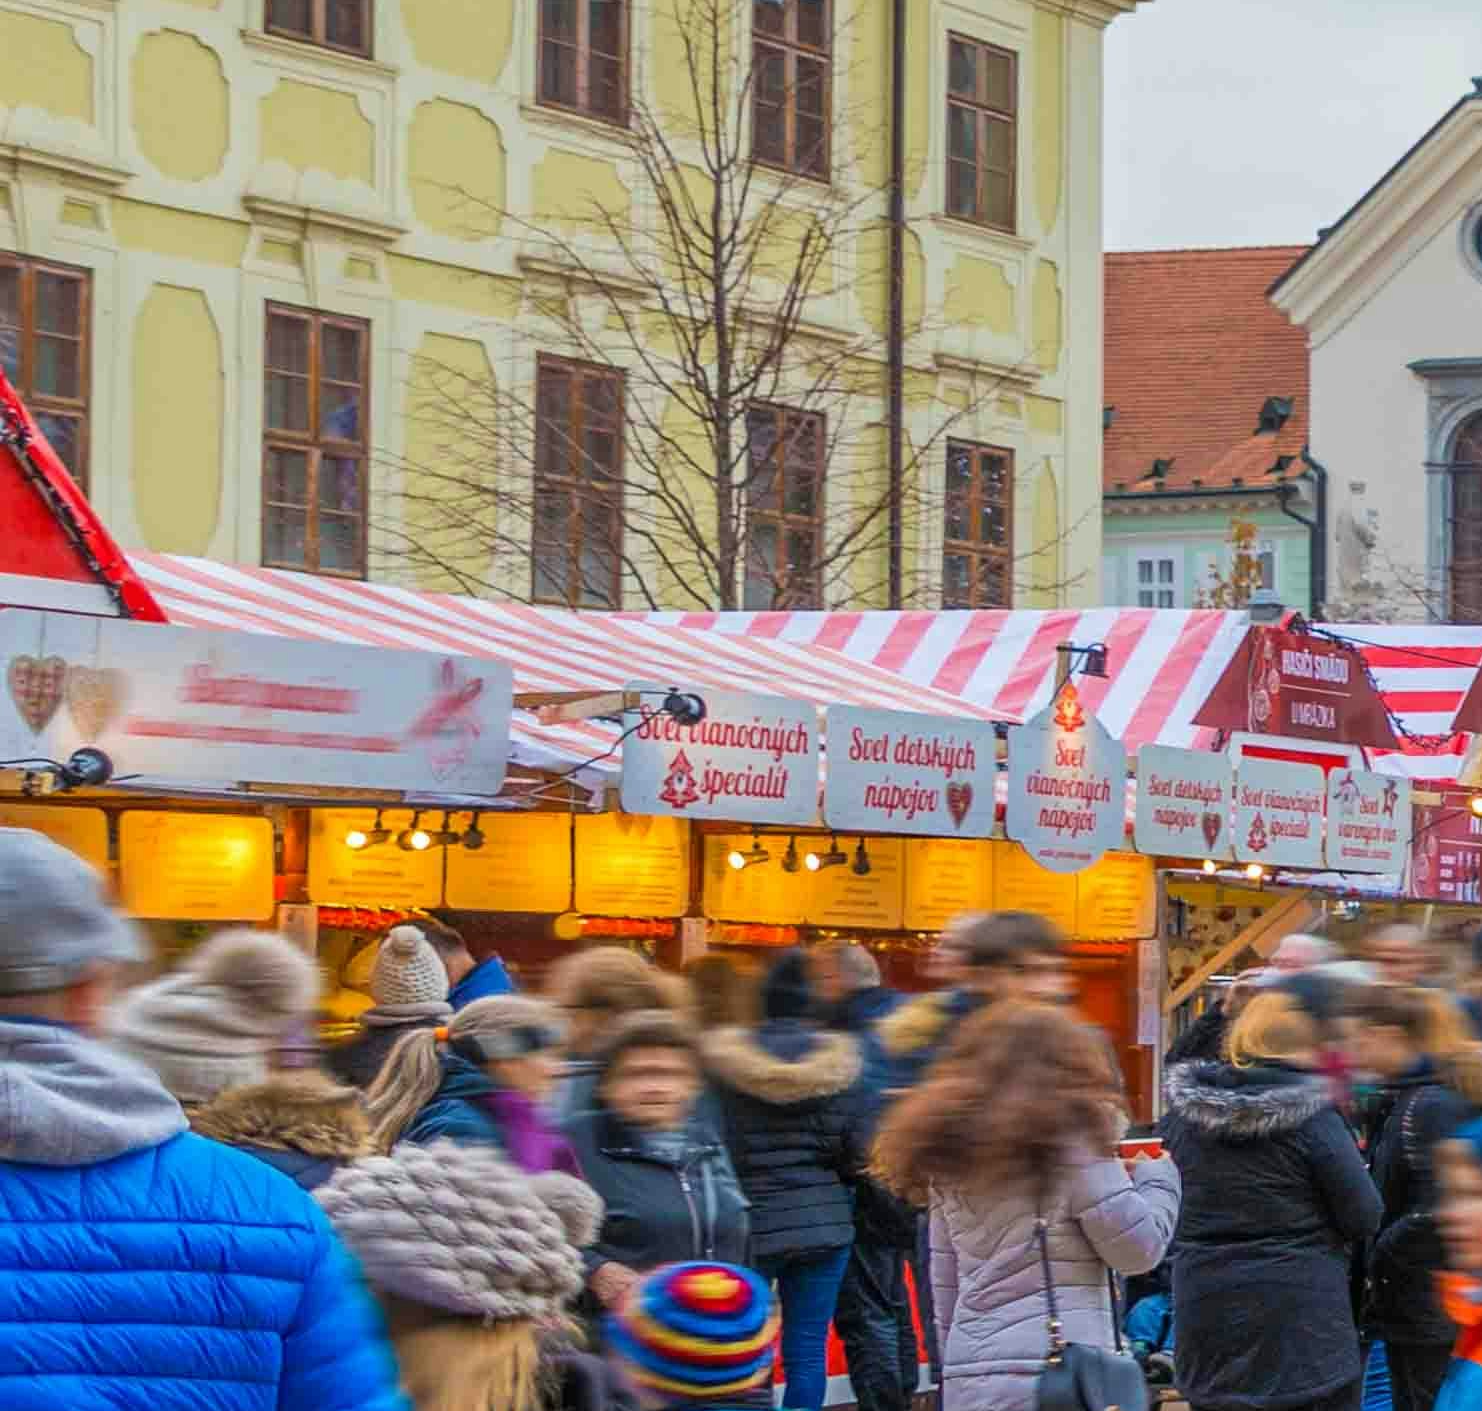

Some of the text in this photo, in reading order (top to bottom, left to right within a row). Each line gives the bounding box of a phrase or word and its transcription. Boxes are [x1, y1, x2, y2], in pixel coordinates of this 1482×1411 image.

[849, 727, 976, 779] Svet detských
[1055, 740, 1087, 768] Svet
[864, 776, 939, 821] nápojov
[1026, 769, 1112, 812] vianočných
[1148, 774, 1174, 798] Svet
[1037, 799, 1097, 840] nápojov
[1152, 802, 1198, 834] nápojov
